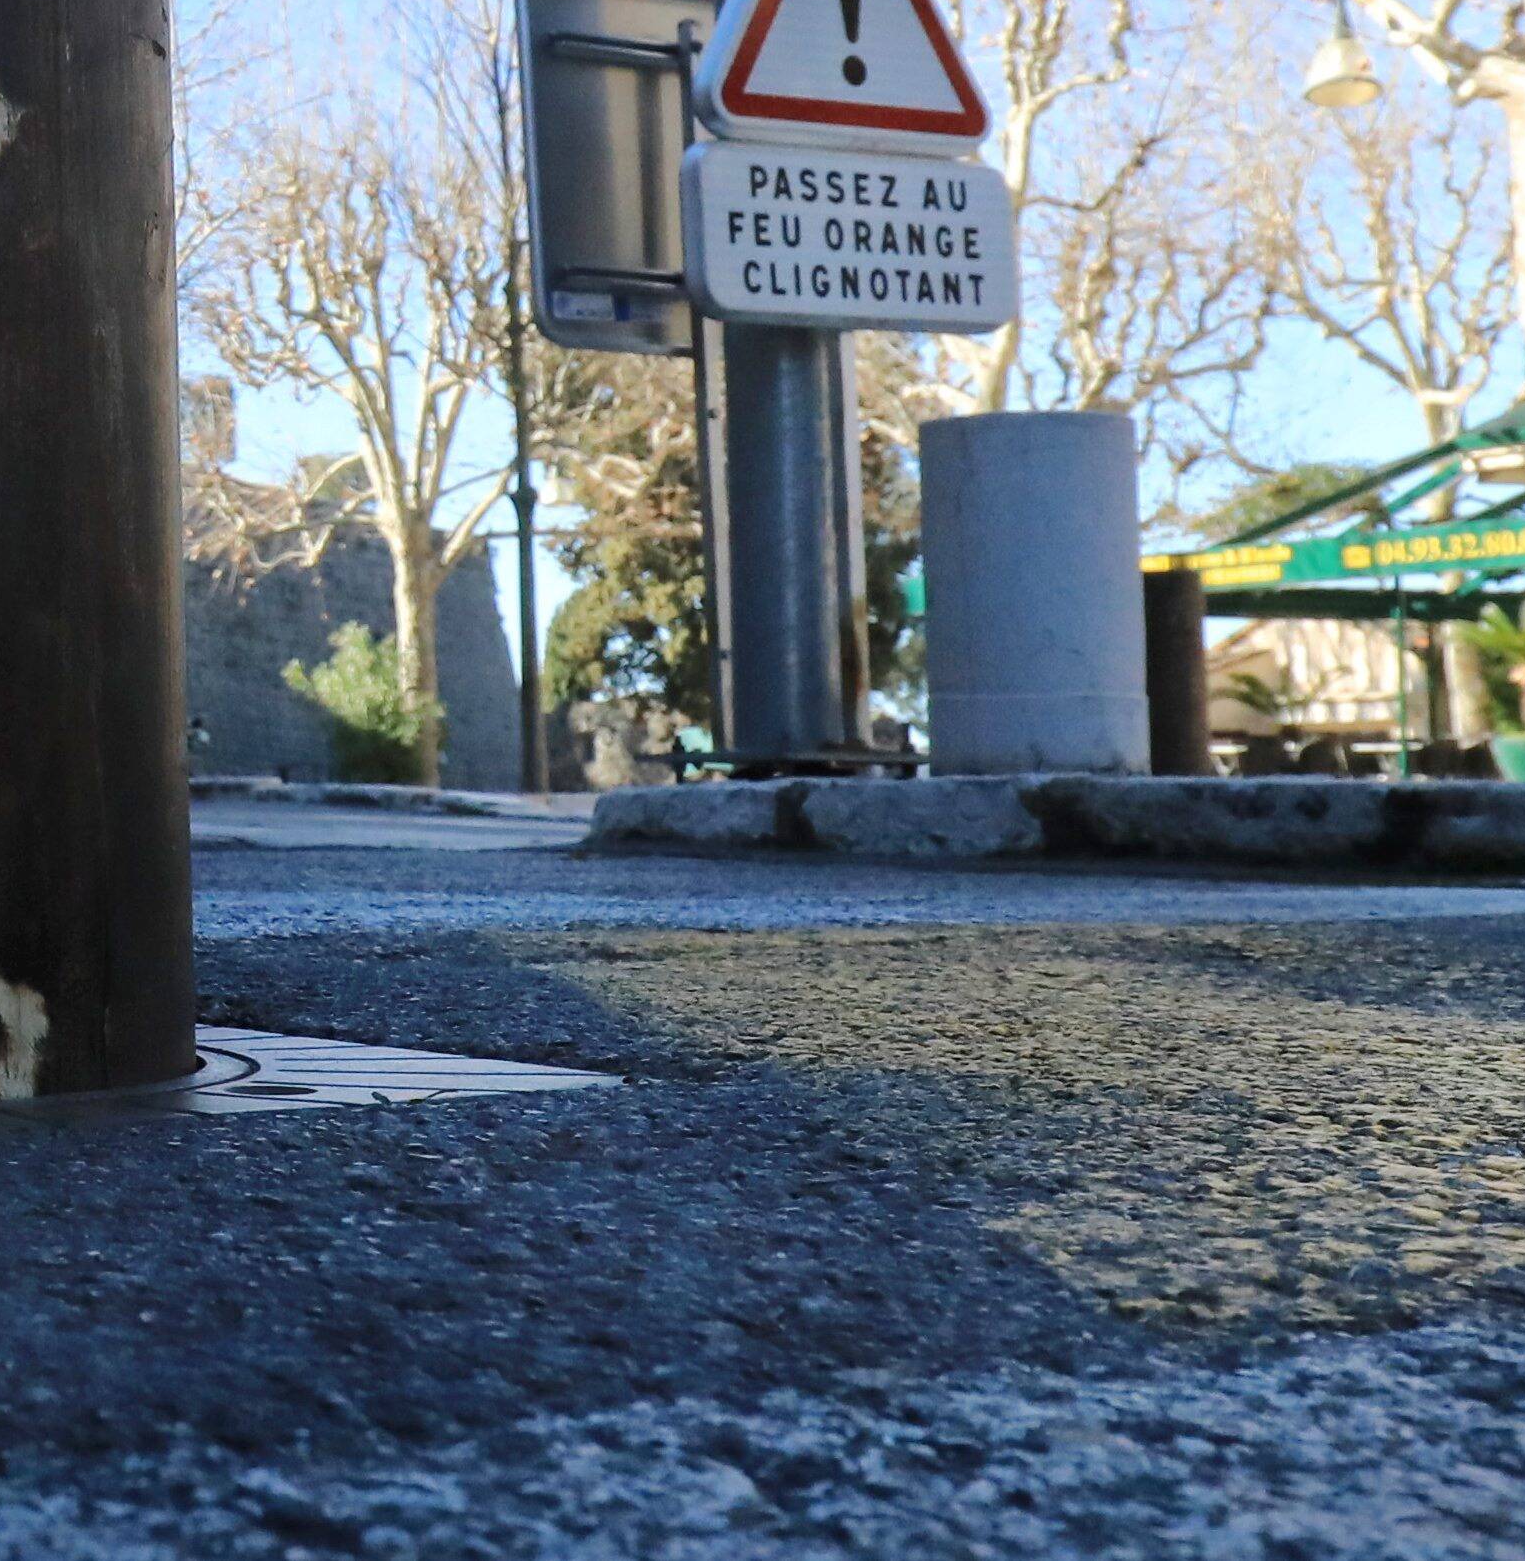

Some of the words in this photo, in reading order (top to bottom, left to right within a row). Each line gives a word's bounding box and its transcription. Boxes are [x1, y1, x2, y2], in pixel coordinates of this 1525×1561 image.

[749, 165, 899, 208] PASSEZ
[923, 178, 967, 212] AU
[728, 211, 801, 248] FEU
[825, 218, 981, 259] ORANGE
[743, 260, 984, 306] CLIGNOTANT
